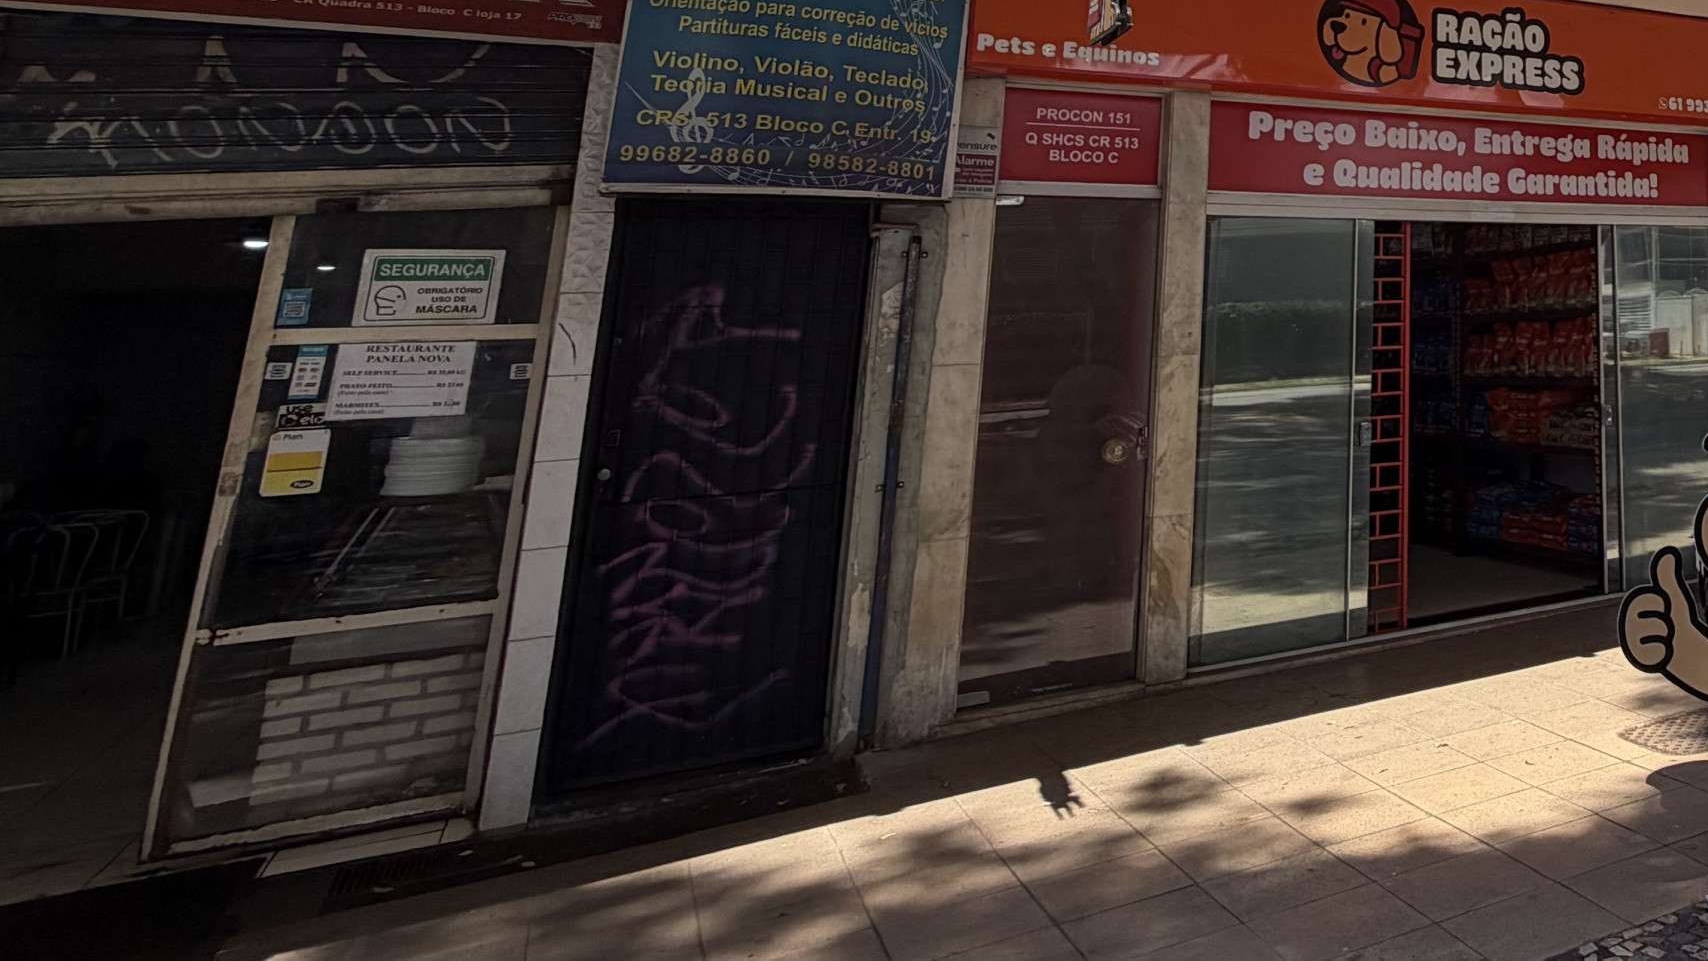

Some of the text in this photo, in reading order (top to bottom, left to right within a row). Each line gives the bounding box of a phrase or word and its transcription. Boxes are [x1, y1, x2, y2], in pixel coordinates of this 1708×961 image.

[375, 0, 404, 12] 513
[417, 4, 456, 17] Bloco
[504, 11, 522, 21] 17
[755, 1, 796, 19] para
[800, 6, 876, 30] correção
[880, 13, 900, 30] de
[903, 19, 949, 39] vícios
[678, 15, 919, 57] Partituras fáceis e didáticas
[1436, 12, 1547, 53] RAÇÃO
[976, 32, 1161, 67] Pets e Equinos
[653, 50, 835, 81] Violino, Violão,
[1436, 47, 1581, 91] EXPRESS
[650, 74, 927, 113] Teoria Musical e Outros
[1668, 96, 1684, 112] 61
[706, 112, 824, 134] 513 Bloco
[1036, 106, 1132, 125] PROCON 151
[1025, 131, 1140, 150] Q SHCS CR 513
[1248, 110, 1690, 165] Preço Baixo, Entrega Rápida
[619, 144, 772, 166] 99682-8860
[807, 152, 937, 181] 98582-8801
[1049, 149, 1120, 165] BLOCO C
[1302, 157, 1660, 200] e Qualidade Garantida!
[379, 262, 487, 279] SEGURANÇA
[415, 303, 478, 314] MÁSCARA
[453, 295, 468, 303] DE
[365, 344, 457, 354] RESTAURANTE
[365, 354, 452, 364] PANELA NOVA
